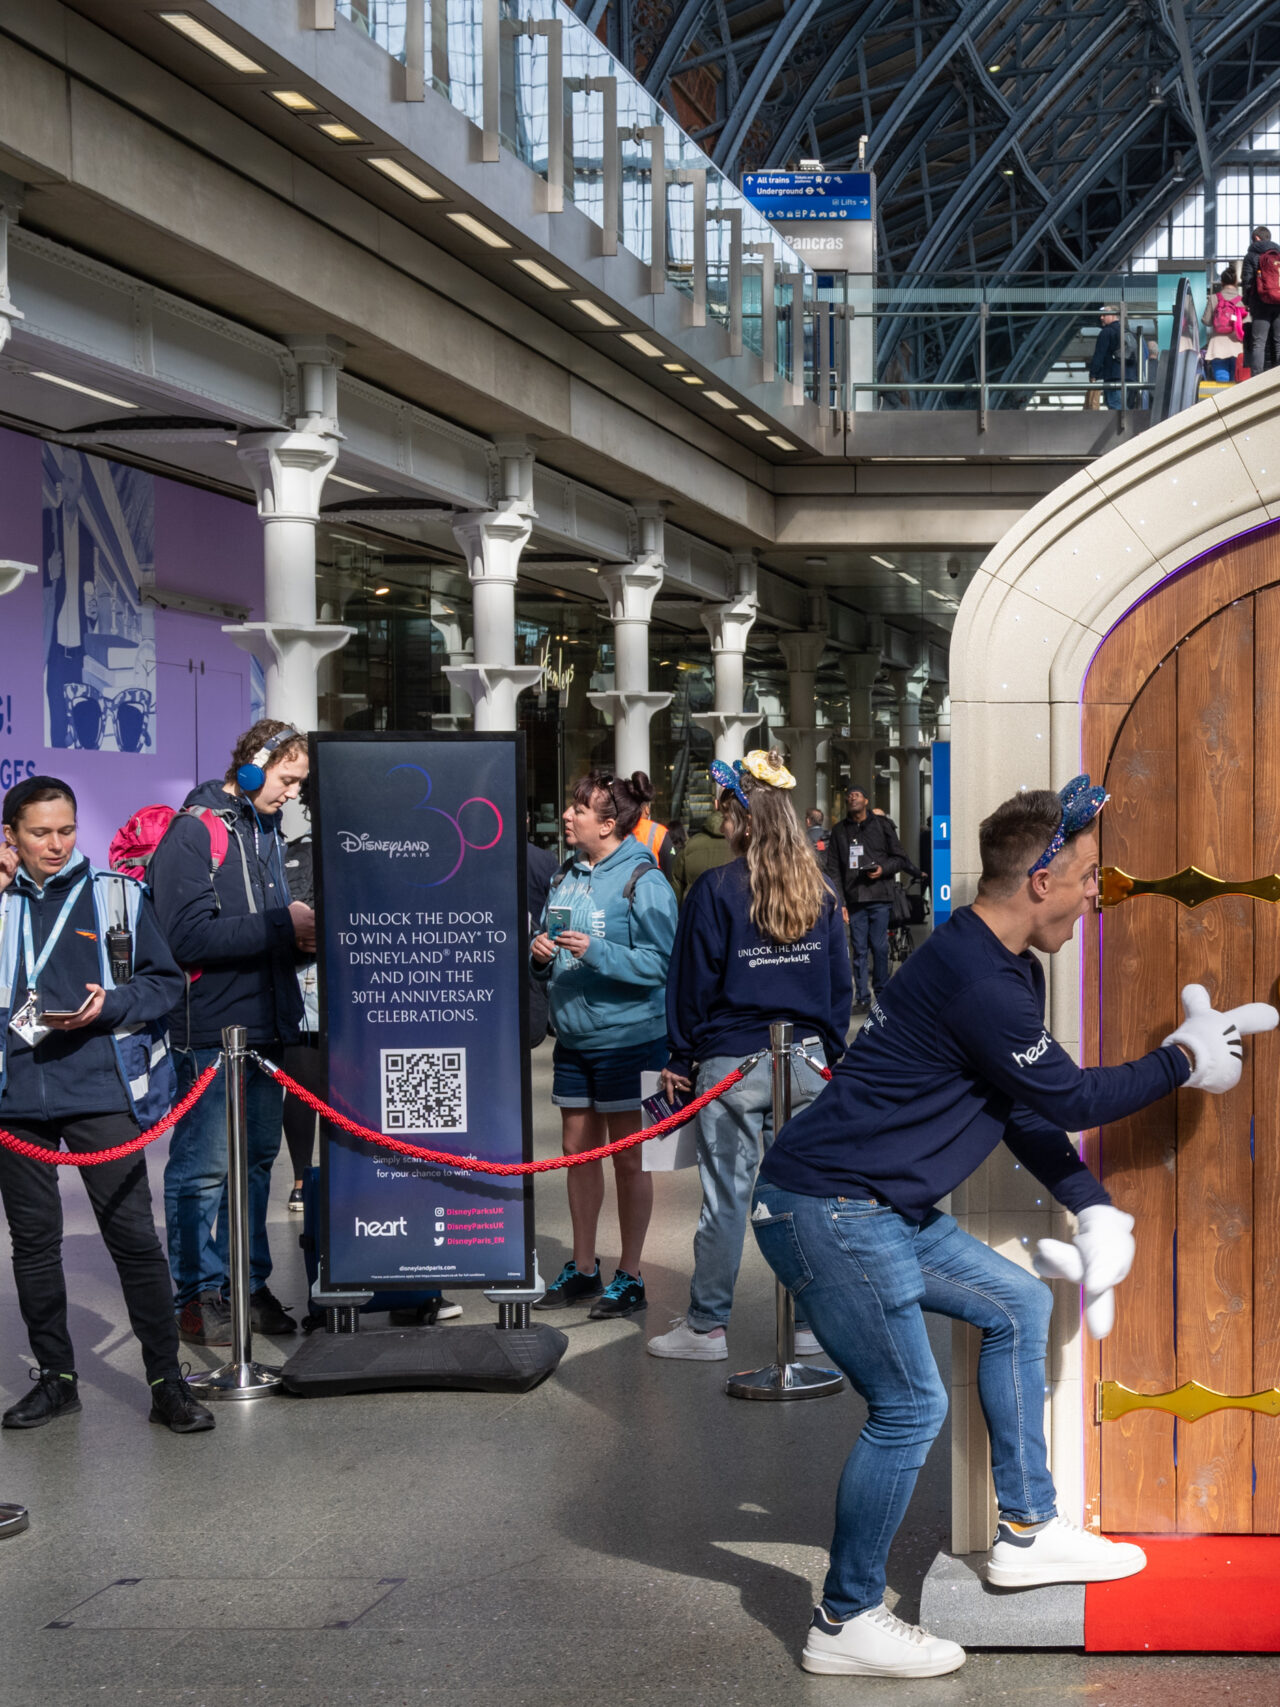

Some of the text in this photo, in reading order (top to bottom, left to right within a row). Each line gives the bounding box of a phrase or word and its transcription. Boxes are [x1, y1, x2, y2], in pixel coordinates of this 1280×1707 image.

[757, 176, 790, 184] All trains
[757, 187, 804, 196] Underground
[939, 822, 948, 839] 1
[349, 911, 494, 926] UNLOCK THE DOOR
[337, 932, 357, 945] TO
[361, 932, 392, 945] WIN
[396, 932, 408, 945] A
[486, 930, 507, 944] TO
[455, 950, 496, 964] PARIS
[737, 941, 822, 958] UNLOCK THE MAGIC
[748, 953, 810, 968] @DisneyParksUK
[370, 970, 474, 986] AND JOIN THE
[351, 989, 494, 1004] 30TH ANNIVERSARY
[367, 1009, 478, 1024] CELEBRATIONS.
[372, 1155, 400, 1165] Simply
[403, 1156, 422, 1164] scan
[376, 1168, 388, 1178] for
[390, 1171, 409, 1180] your
[411, 1169, 441, 1178] chance
[443, 1168, 452, 1177] to
[446, 1207, 504, 1217] DisneyParksUK
[355, 1216, 408, 1237] heart
[447, 1222, 505, 1232] DisneyParksUK
[447, 1237, 505, 1246] DisneyParis_EN
